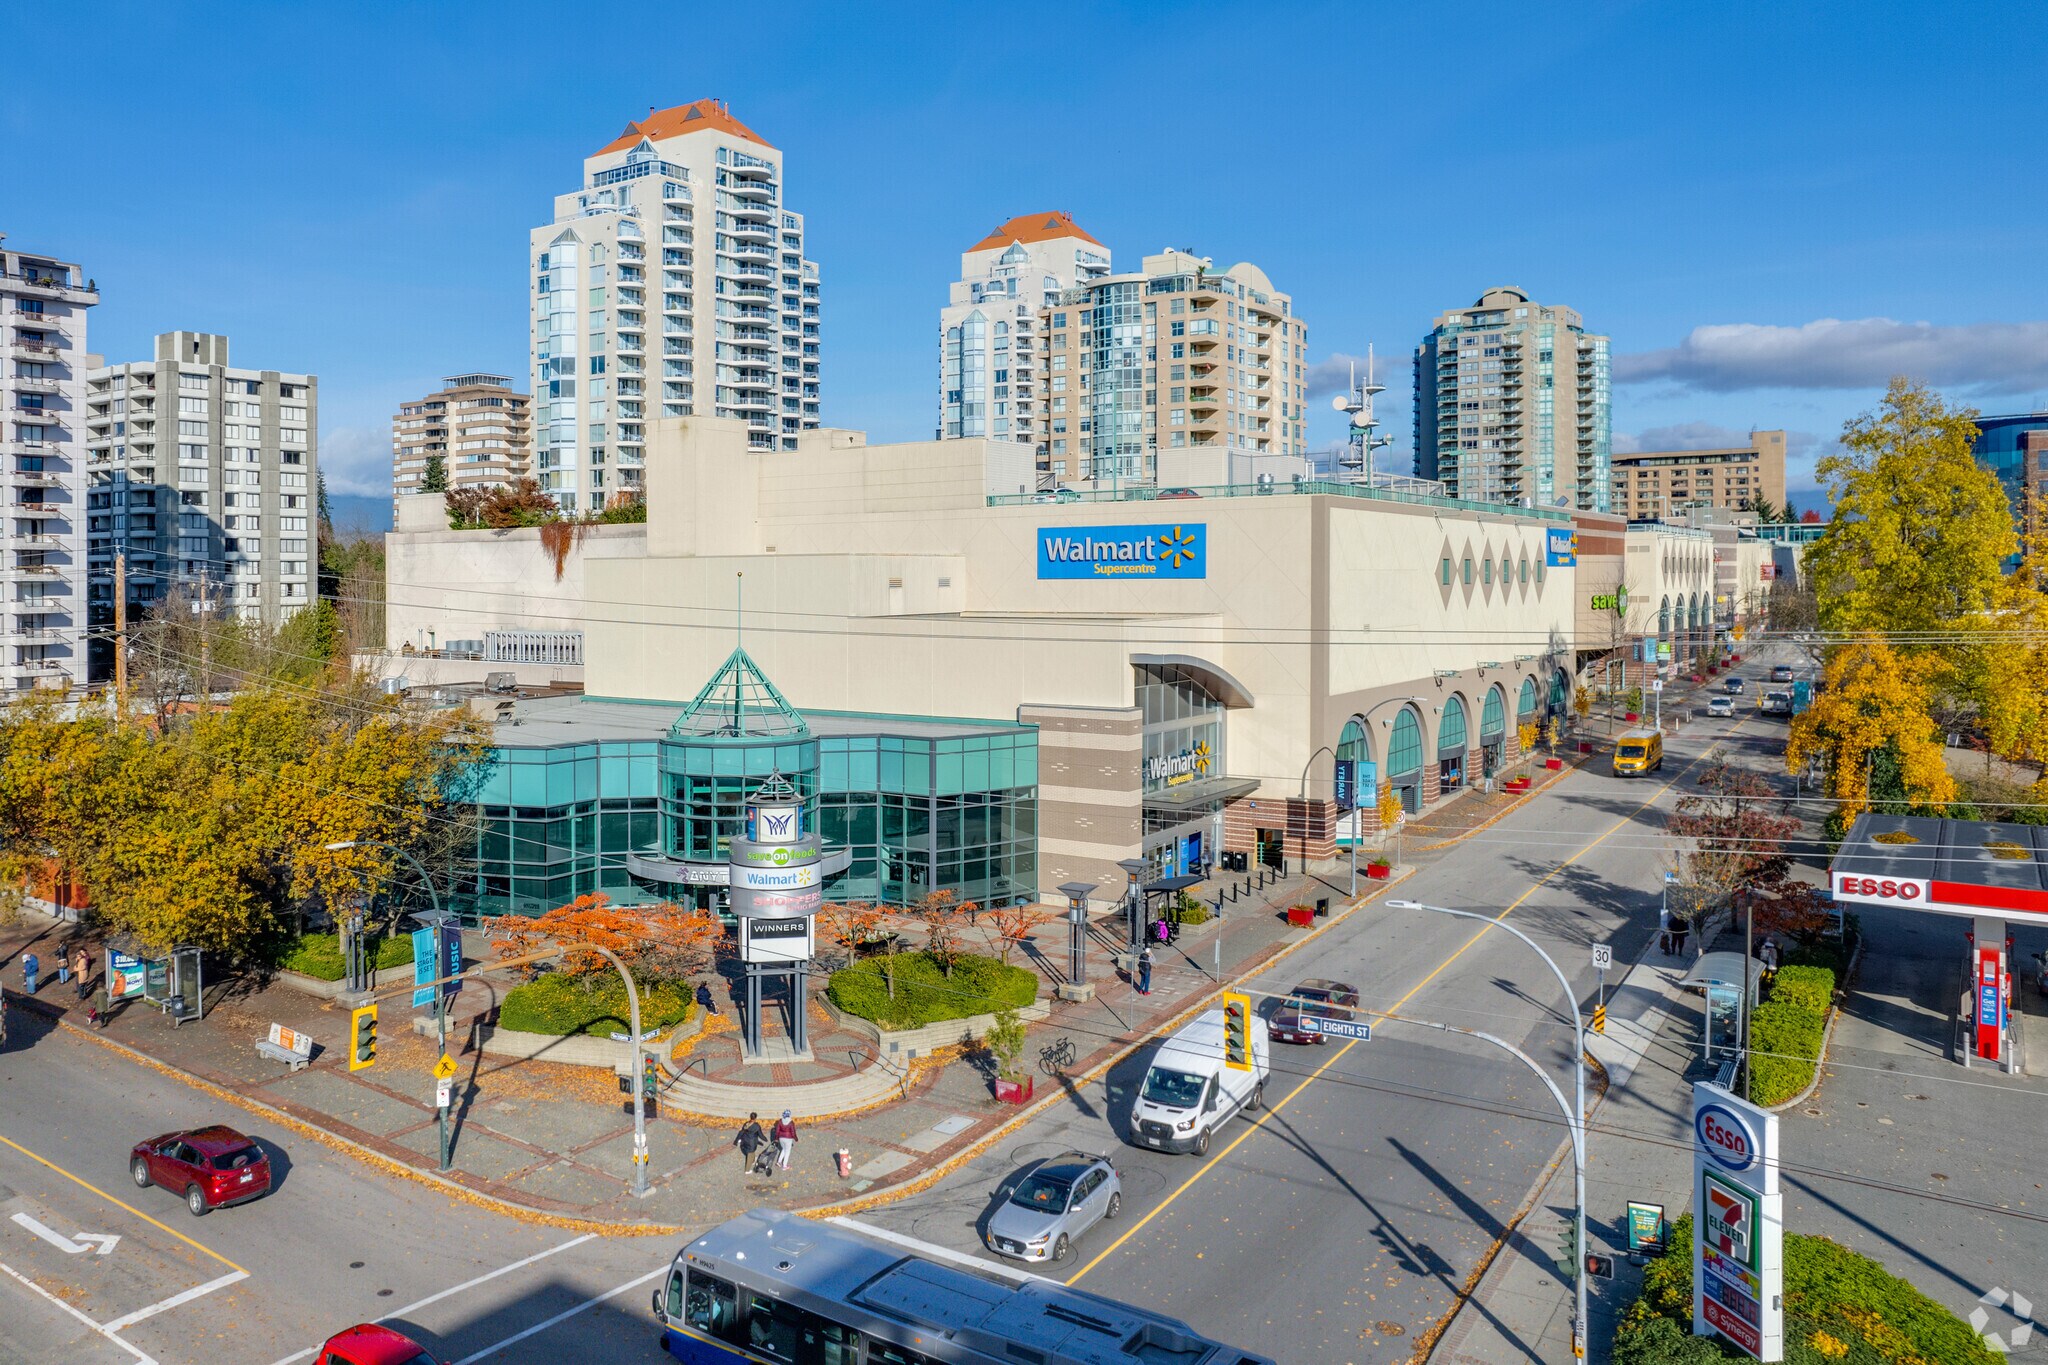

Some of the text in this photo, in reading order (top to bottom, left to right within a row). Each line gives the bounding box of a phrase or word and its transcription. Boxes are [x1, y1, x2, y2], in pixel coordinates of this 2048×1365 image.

[1045, 536, 1156, 562] Walmart
[1094, 563, 1156, 575] Supercentre
[1592, 594, 1616, 610] save
[1150, 750, 1197, 780] Walmart
[690, 870, 729, 882] ANYT
[747, 873, 797, 885] Walmart
[1841, 877, 1920, 899] ESSO
[754, 923, 804, 932] WINNERS
[422, 949, 433, 959] THE
[1595, 949, 1609, 963] 30
[417, 957, 433, 968] STAGE
[423, 964, 433, 973] SET
[1323, 1021, 1368, 1038] EIGHTH ST
[1705, 1116, 1745, 1155] Esso
[1720, 1315, 1756, 1348] Synergy
